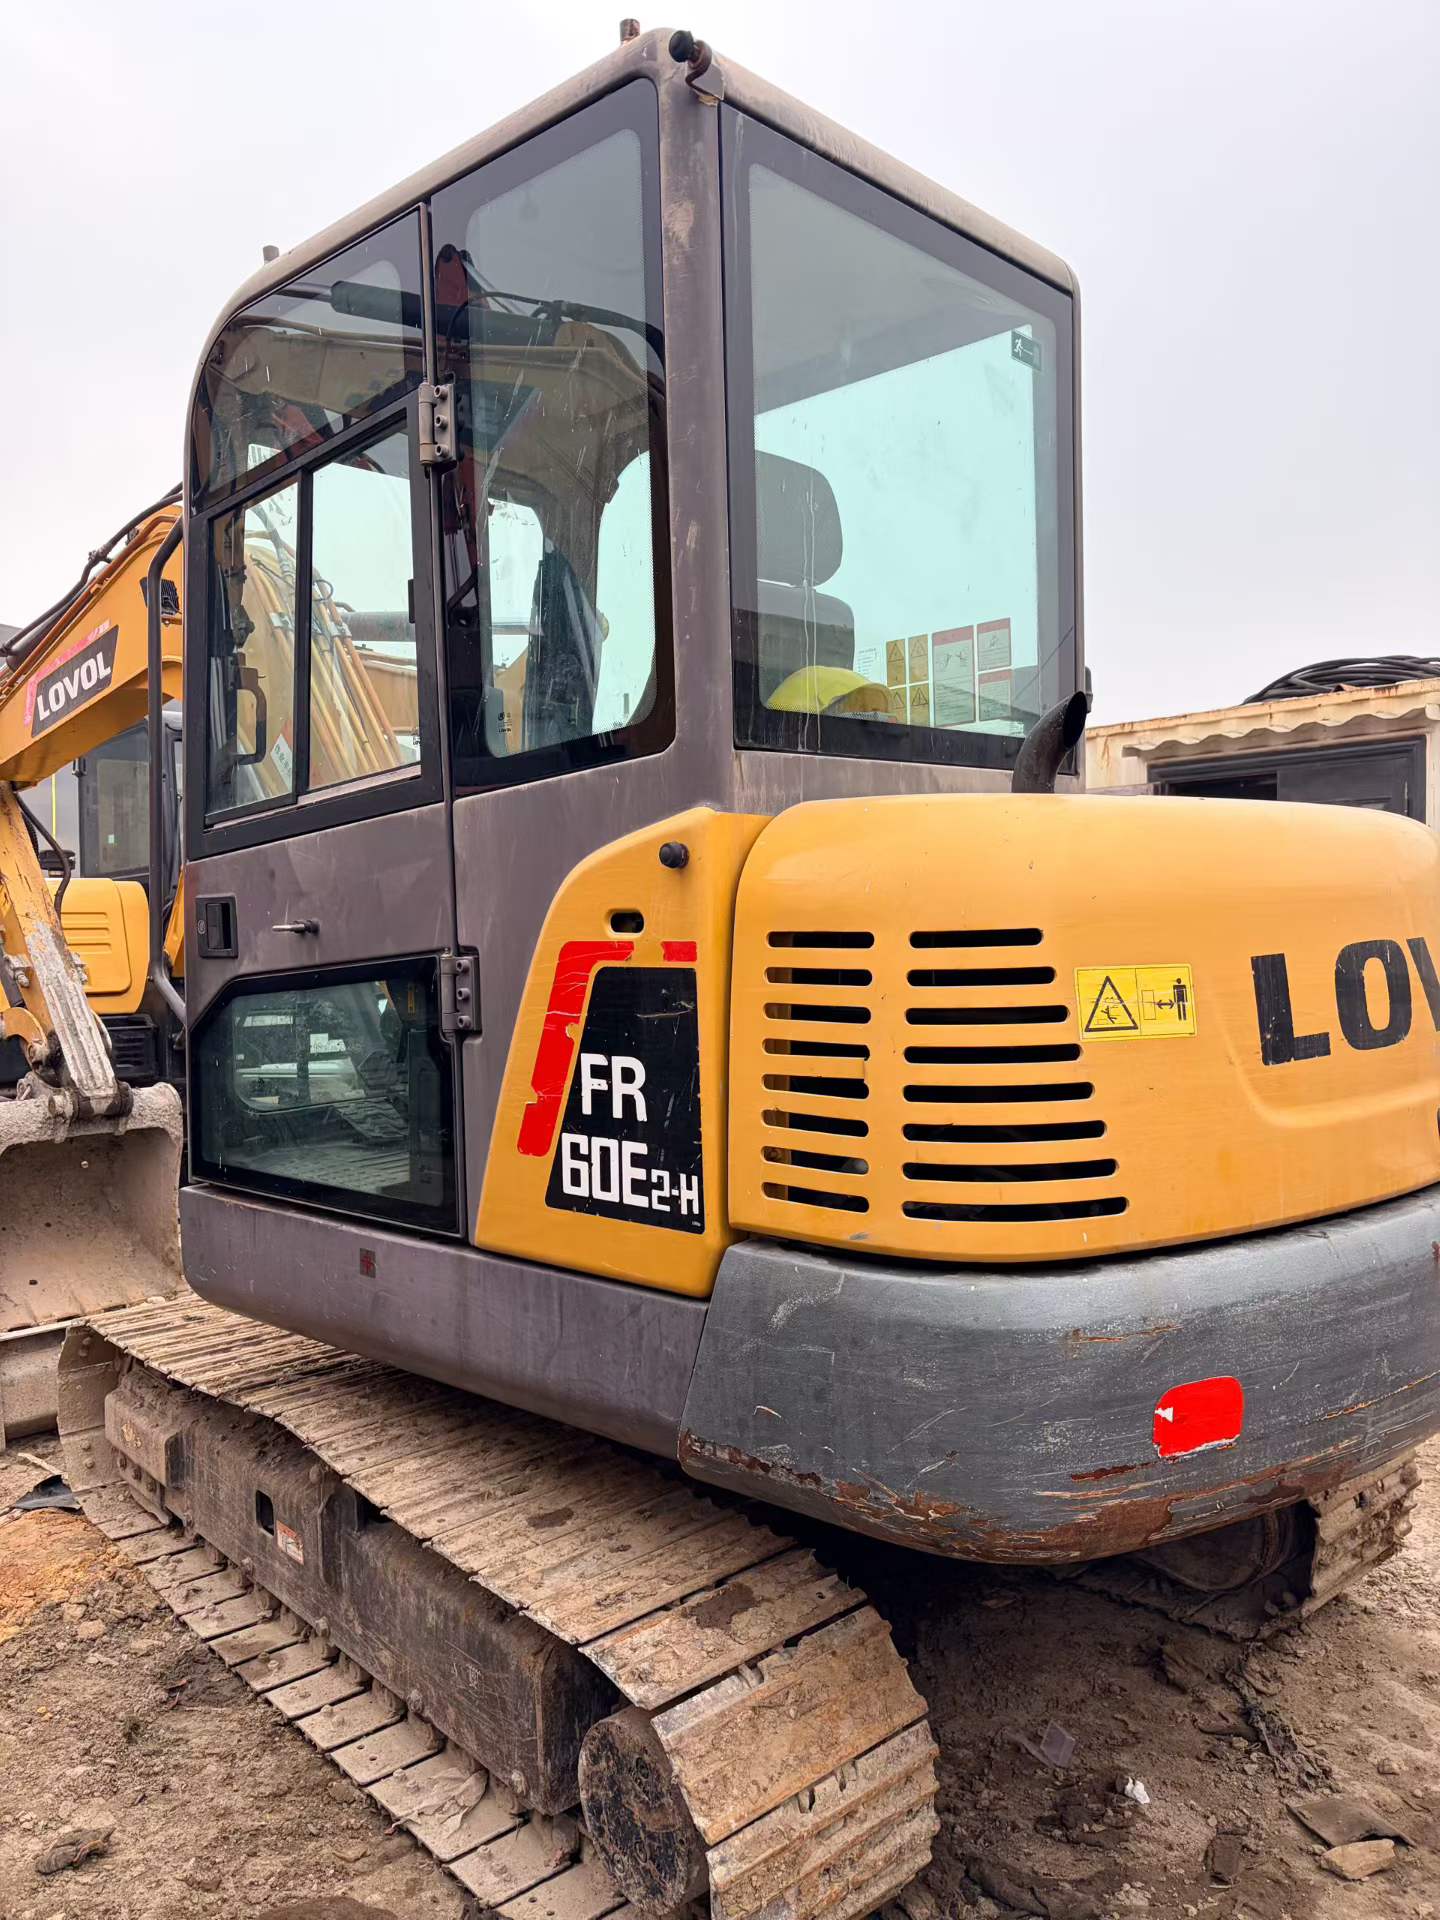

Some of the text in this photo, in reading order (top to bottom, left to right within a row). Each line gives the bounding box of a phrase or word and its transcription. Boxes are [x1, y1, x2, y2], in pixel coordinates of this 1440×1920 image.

[37, 651, 112, 721] LOVOL
[580, 1053, 648, 1122] FR
[561, 1132, 699, 1215] 60E2-H
